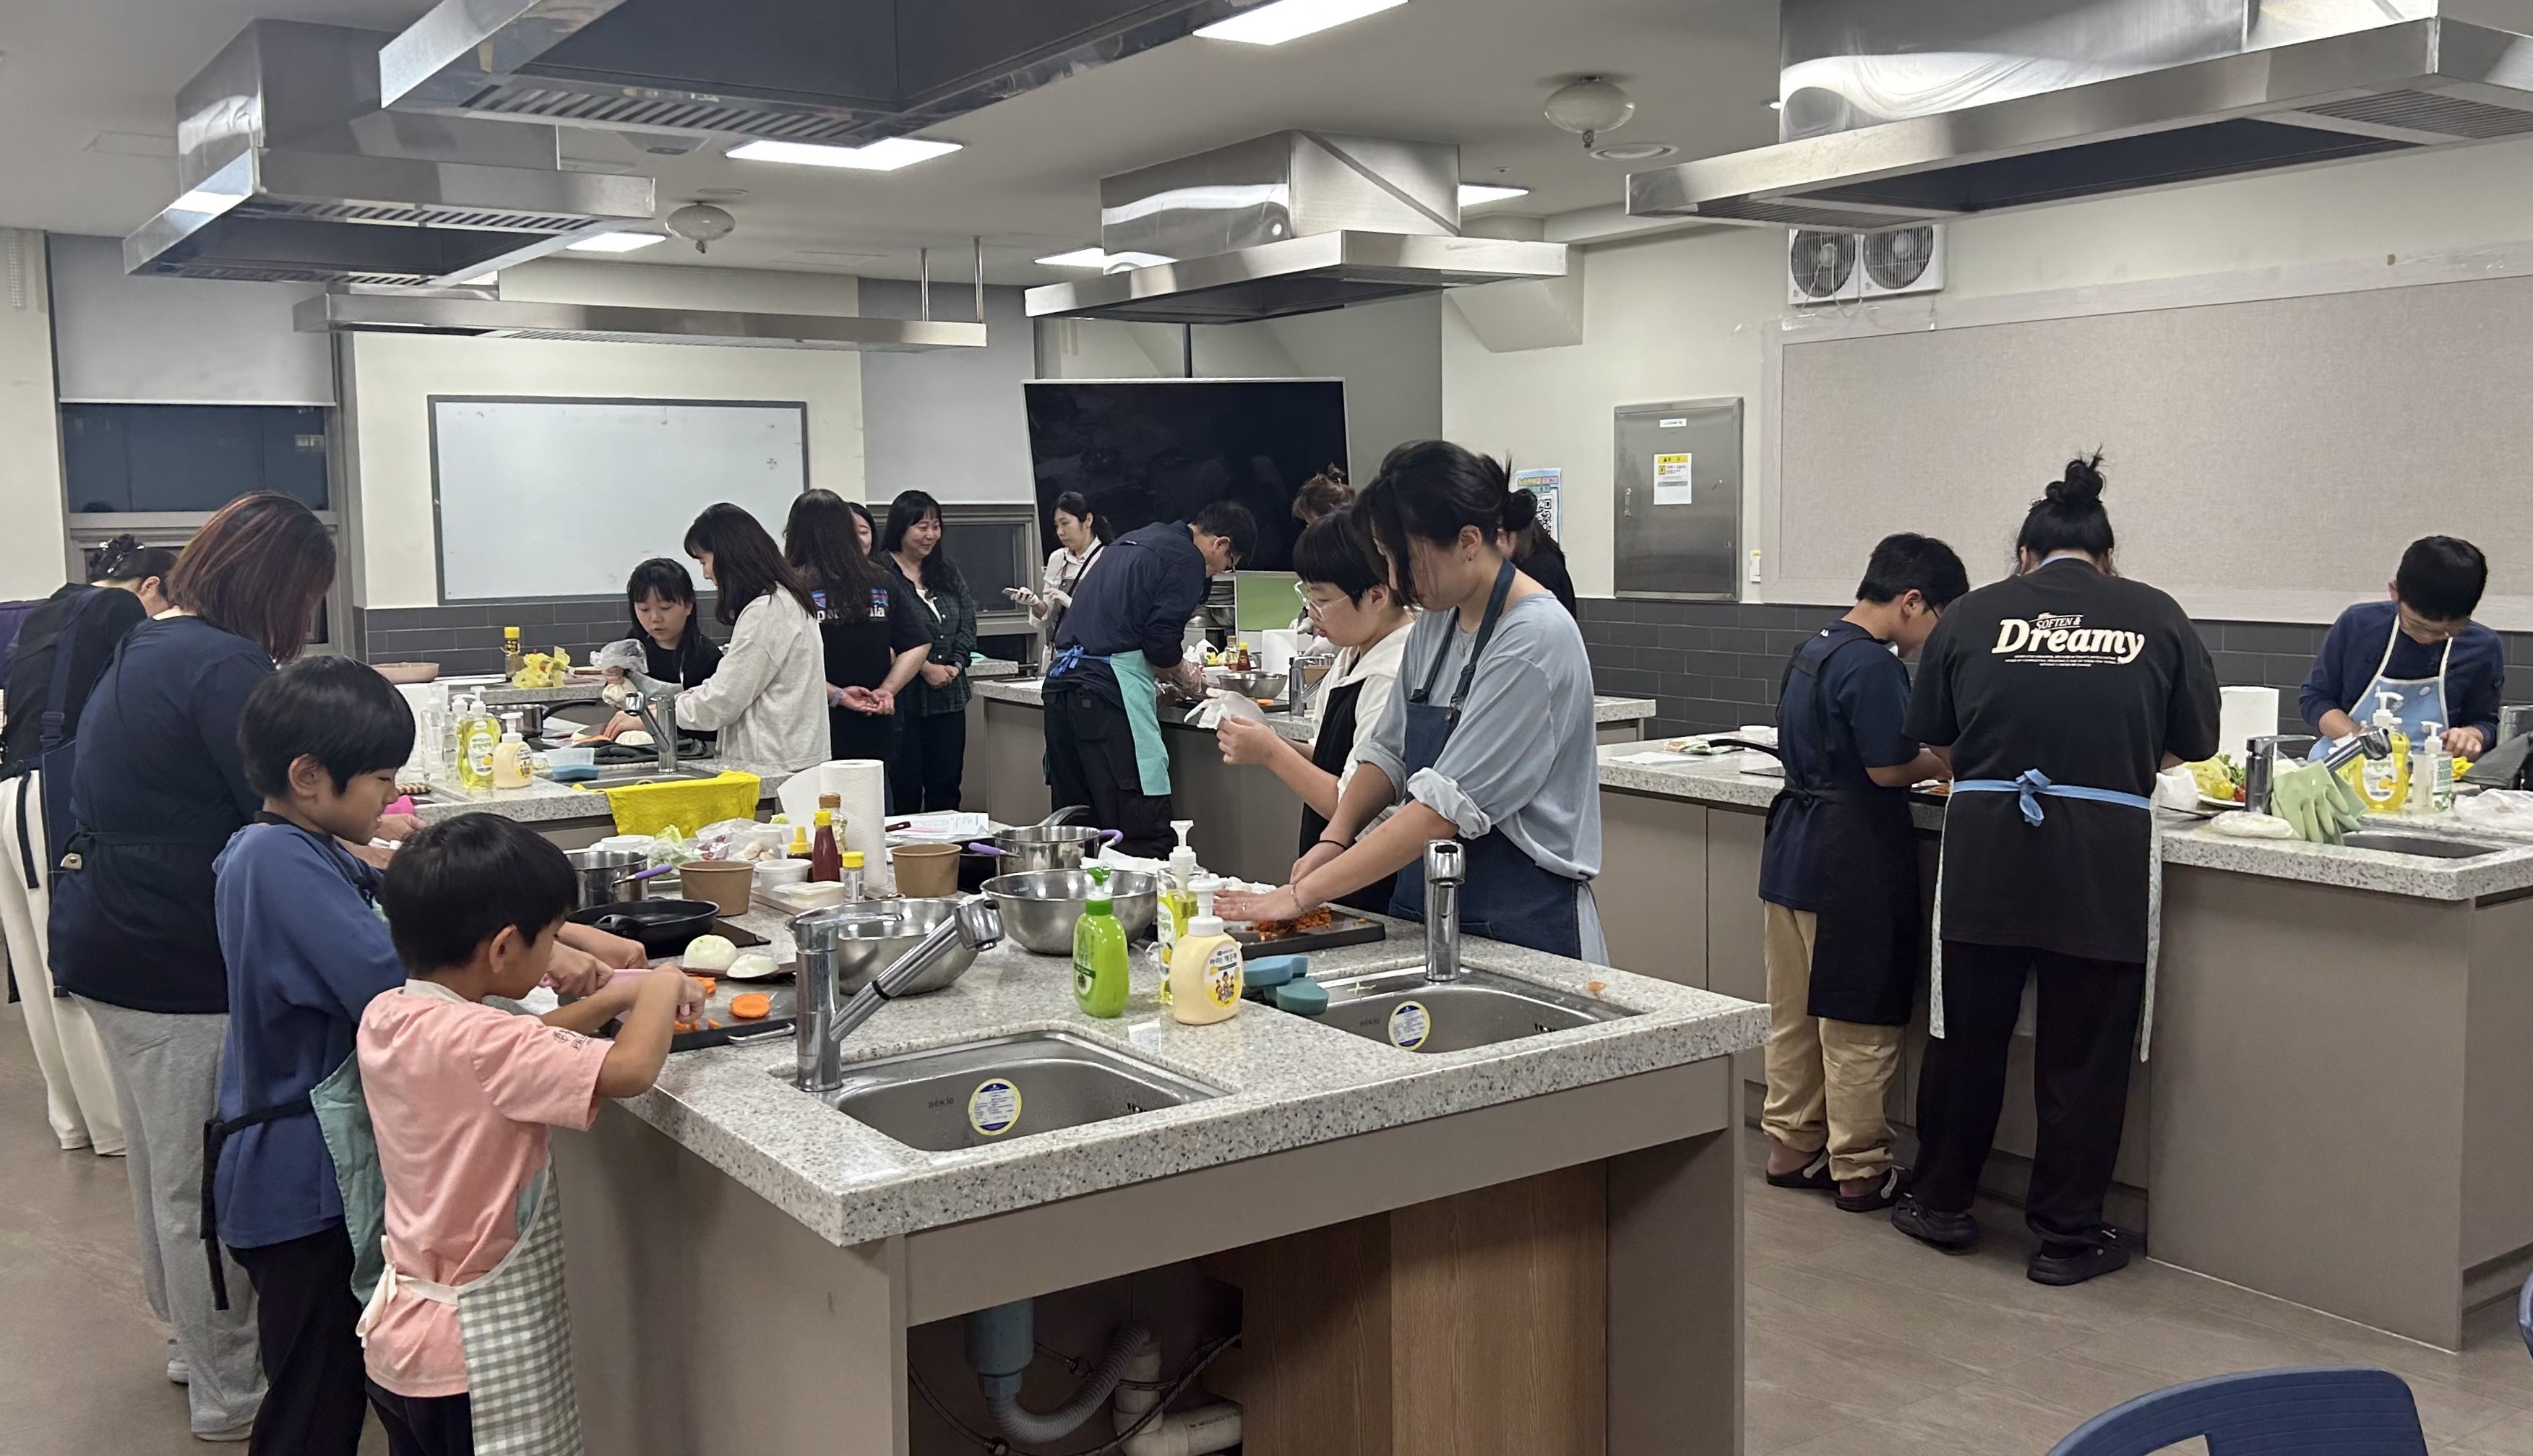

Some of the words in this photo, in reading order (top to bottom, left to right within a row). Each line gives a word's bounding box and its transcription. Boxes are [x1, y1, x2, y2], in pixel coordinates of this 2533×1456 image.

[2035, 617, 2074, 631] SOFTEN
[2074, 617, 2081, 626] &
[1991, 619, 2146, 665] Dreamy
